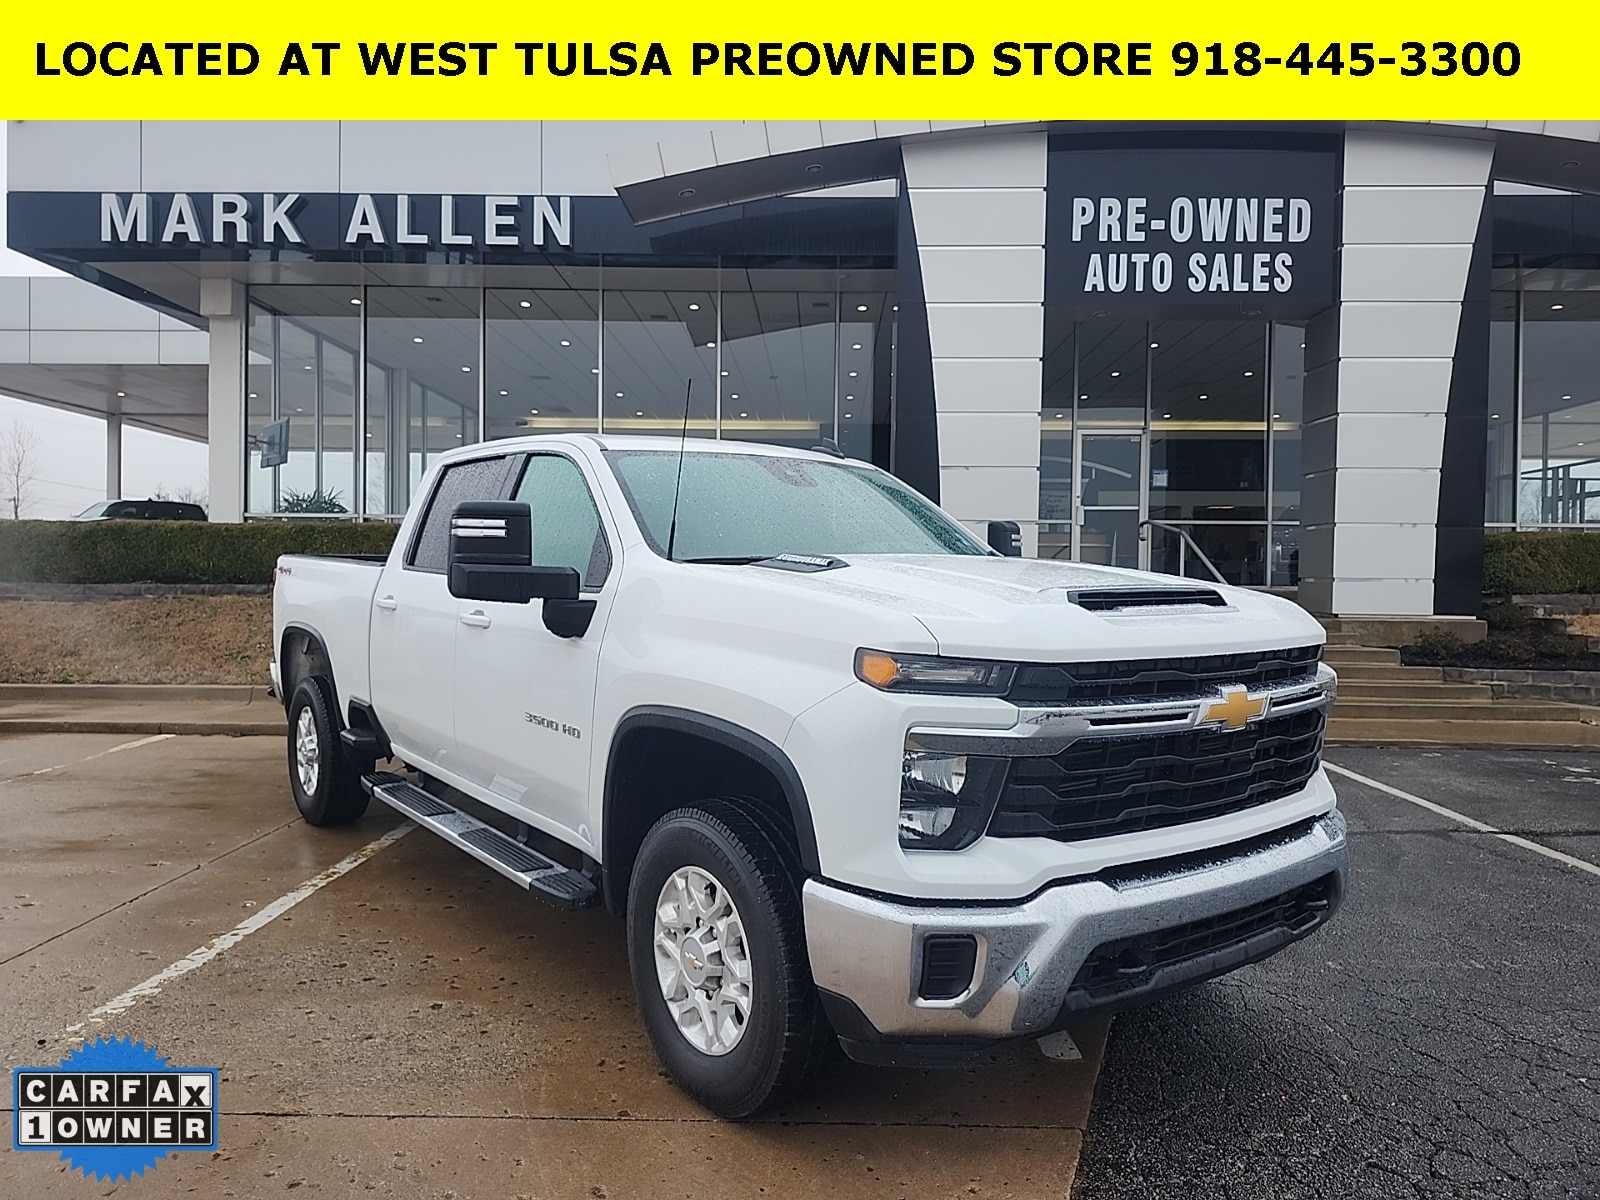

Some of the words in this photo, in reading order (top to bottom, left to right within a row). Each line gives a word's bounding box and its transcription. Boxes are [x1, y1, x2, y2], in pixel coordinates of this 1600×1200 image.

[100, 192, 303, 244] MARK
[344, 194, 573, 247] ALLEN
[1071, 196, 1312, 243] PRE-OWNED
[1083, 252, 1174, 293] AUTO
[1187, 252, 1294, 293] SALES
[524, 711, 560, 732] 3500
[562, 723, 582, 740] HD
